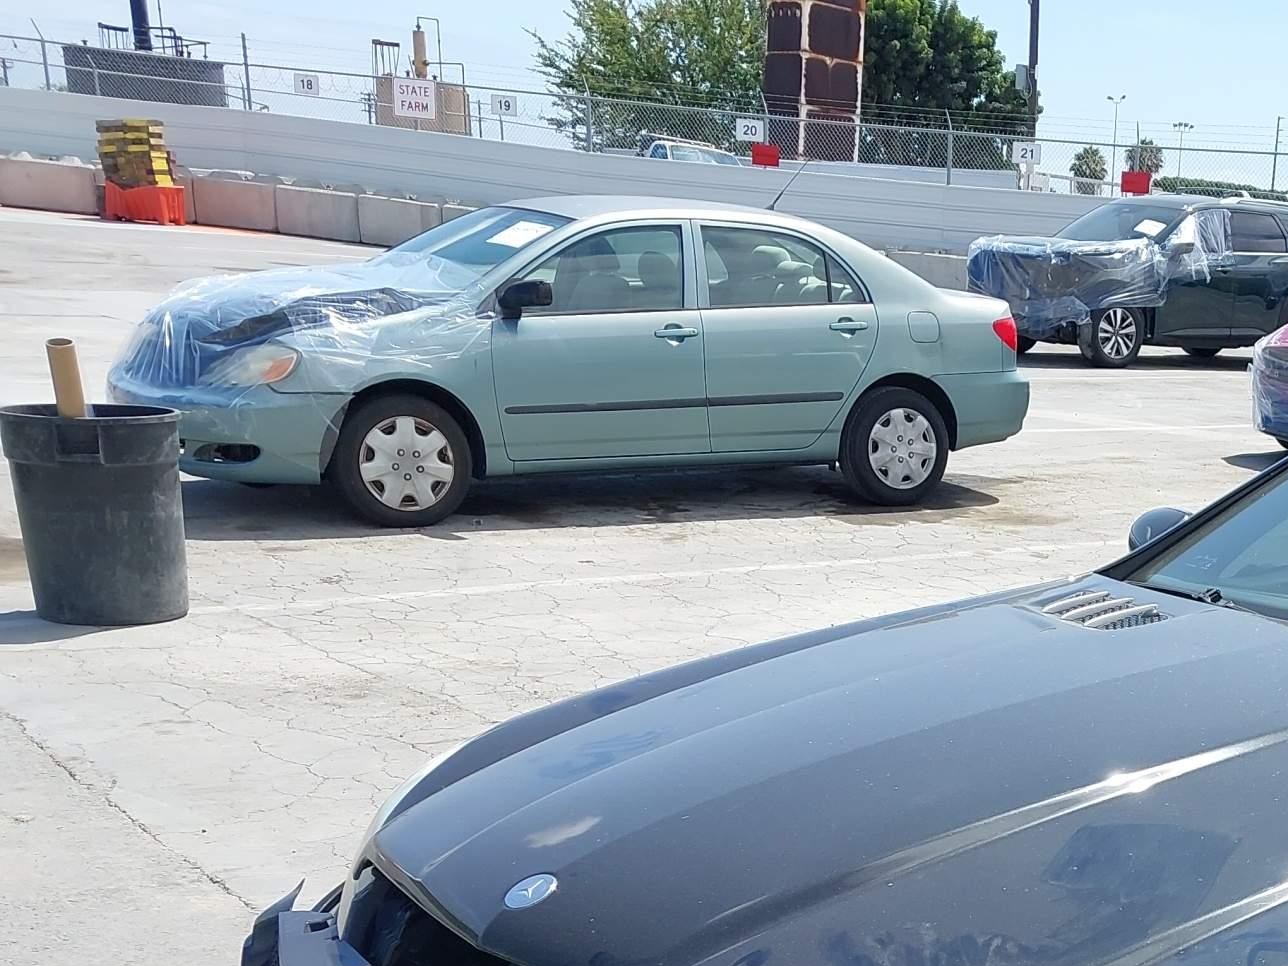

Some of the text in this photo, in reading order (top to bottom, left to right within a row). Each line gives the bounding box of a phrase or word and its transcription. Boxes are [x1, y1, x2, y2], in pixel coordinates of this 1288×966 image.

[300, 79, 313, 90] 18
[399, 84, 430, 97] STATE
[401, 100, 429, 113] FARM
[498, 100, 511, 111] 19
[743, 124, 757, 136] 20
[1020, 147, 1034, 160] 21
